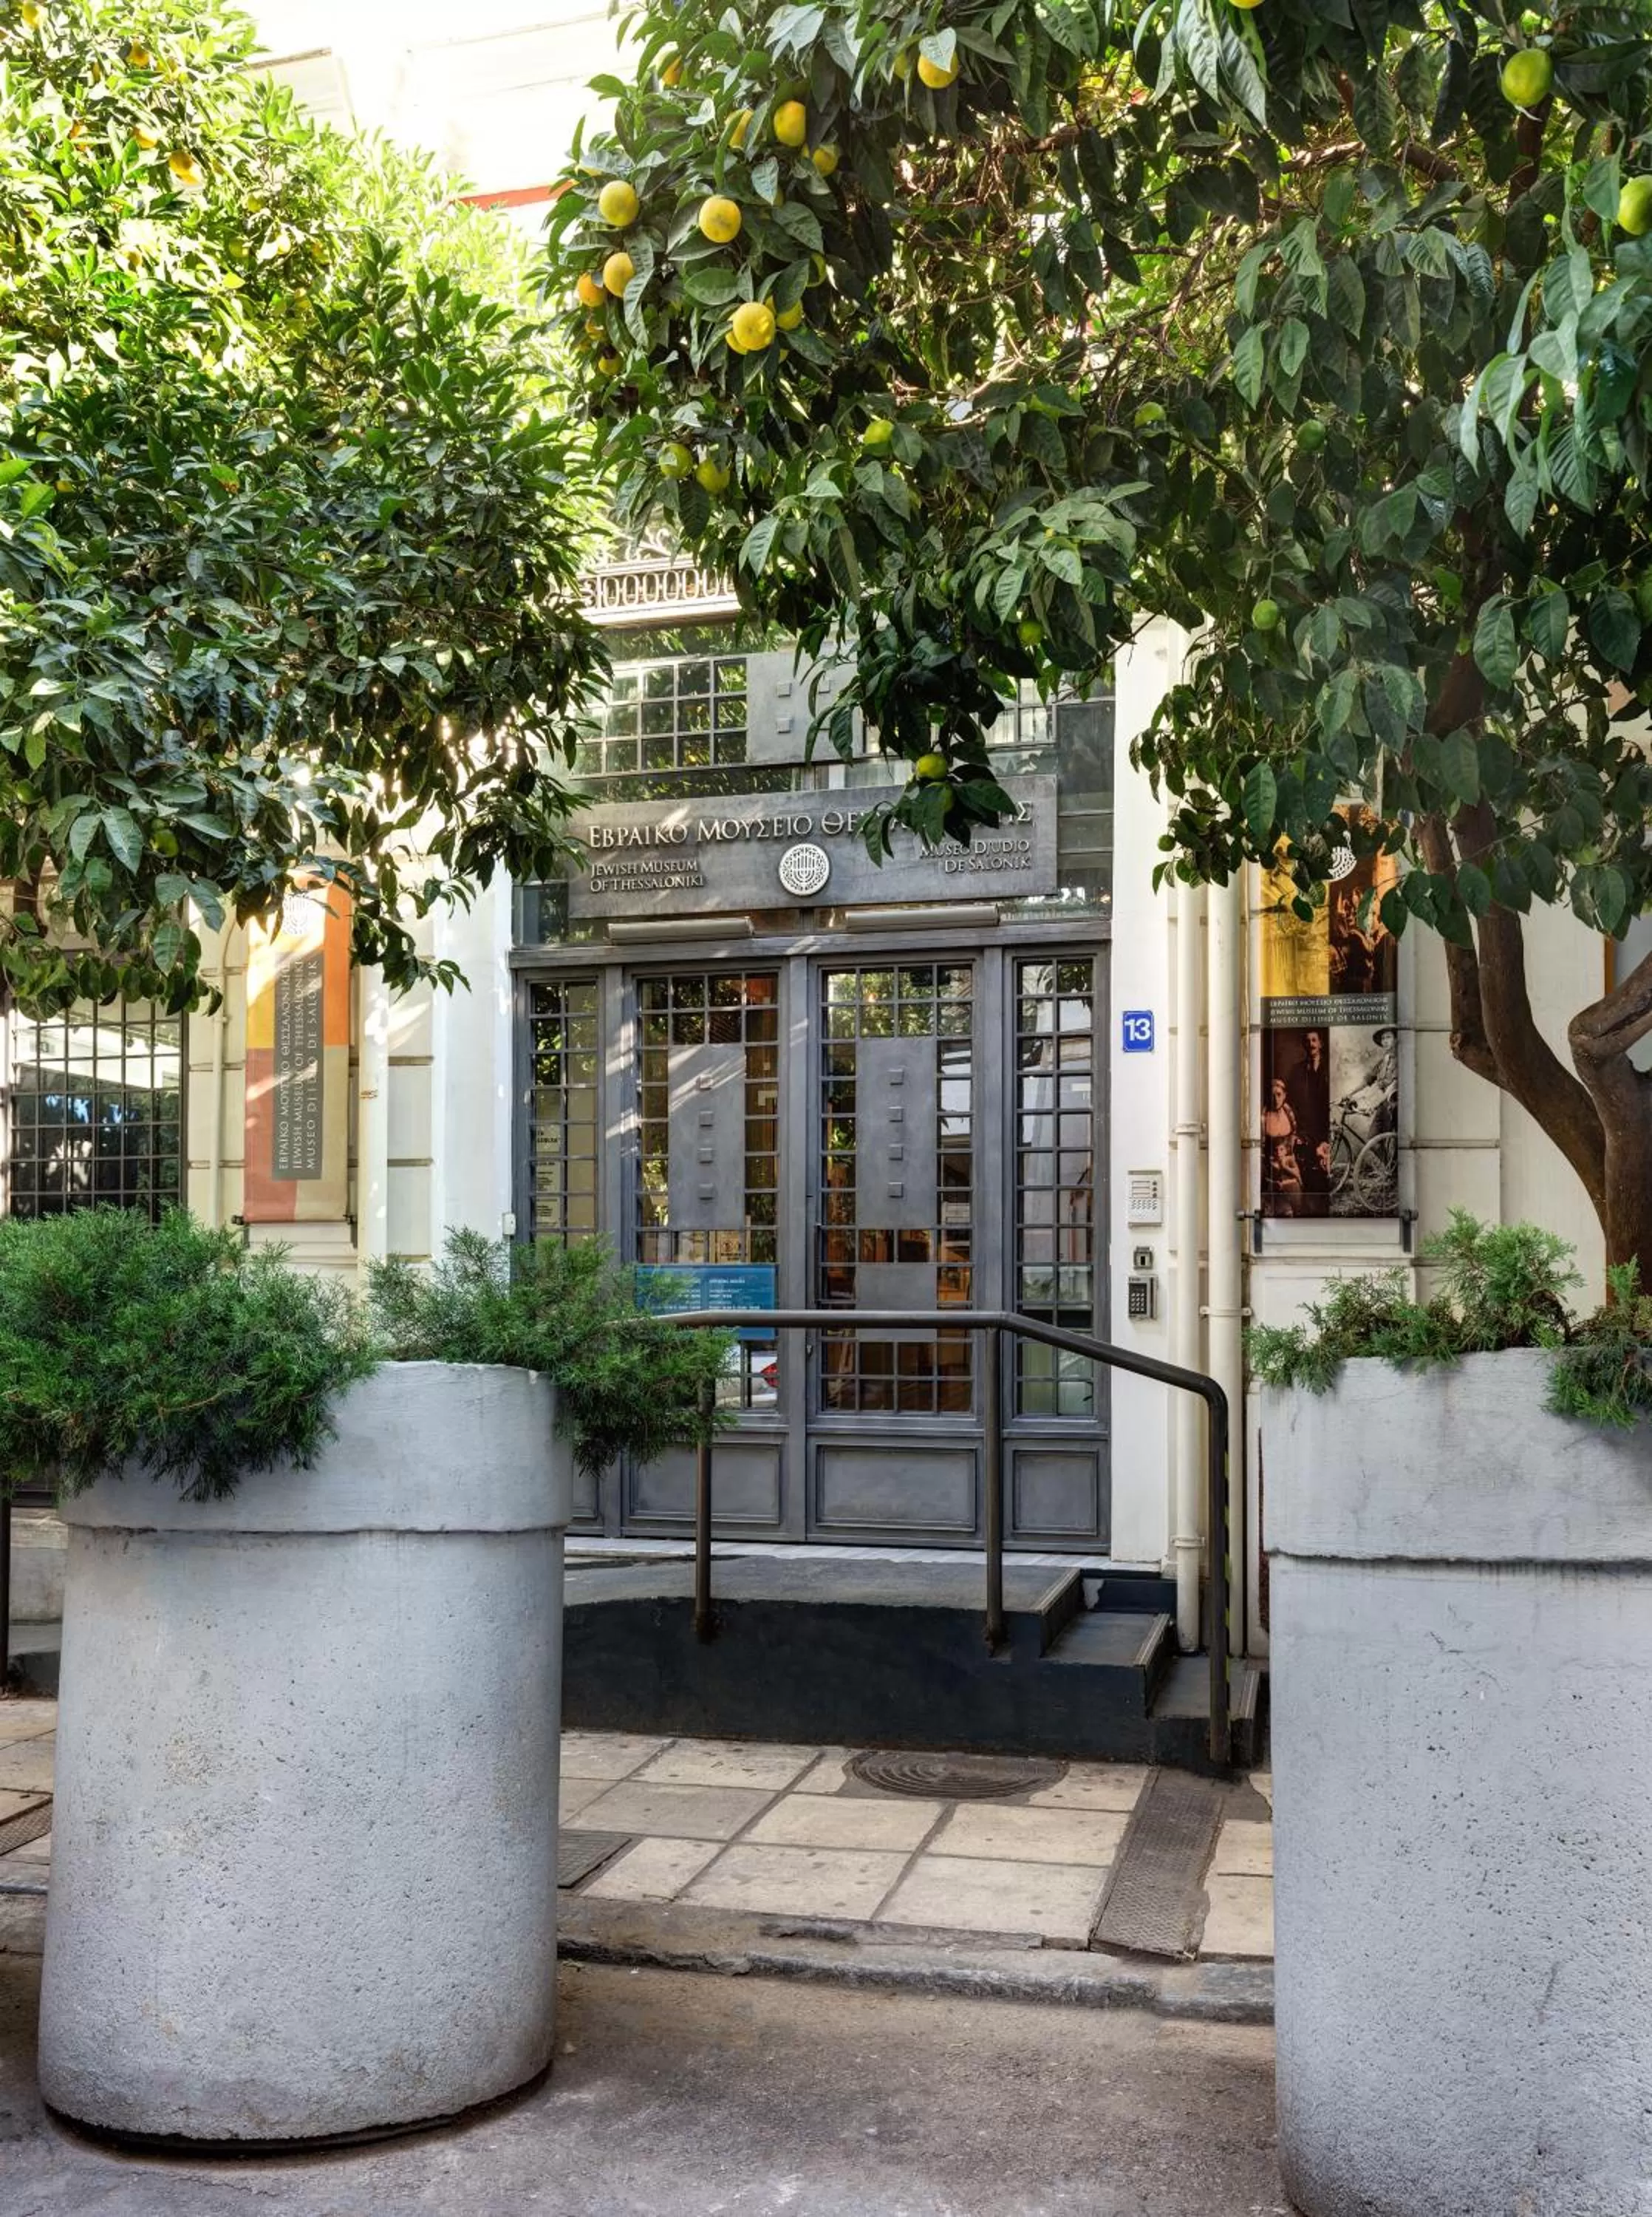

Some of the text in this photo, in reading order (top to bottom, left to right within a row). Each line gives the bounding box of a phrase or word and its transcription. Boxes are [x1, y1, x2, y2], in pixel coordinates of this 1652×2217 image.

[697, 815, 812, 841] ΜΟΥΣΕΙΟ
[591, 860, 697, 878] JEWISH MUSEUM
[945, 859, 964, 873] DE
[591, 874, 703, 892] OF THESSALONIKI
[1124, 1018, 1151, 1041] 13
[307, 1031, 317, 1049] DE
[279, 1060, 290, 1116] ΜΟΥΣΙΟ
[307, 1119, 316, 1170] MUSEO
